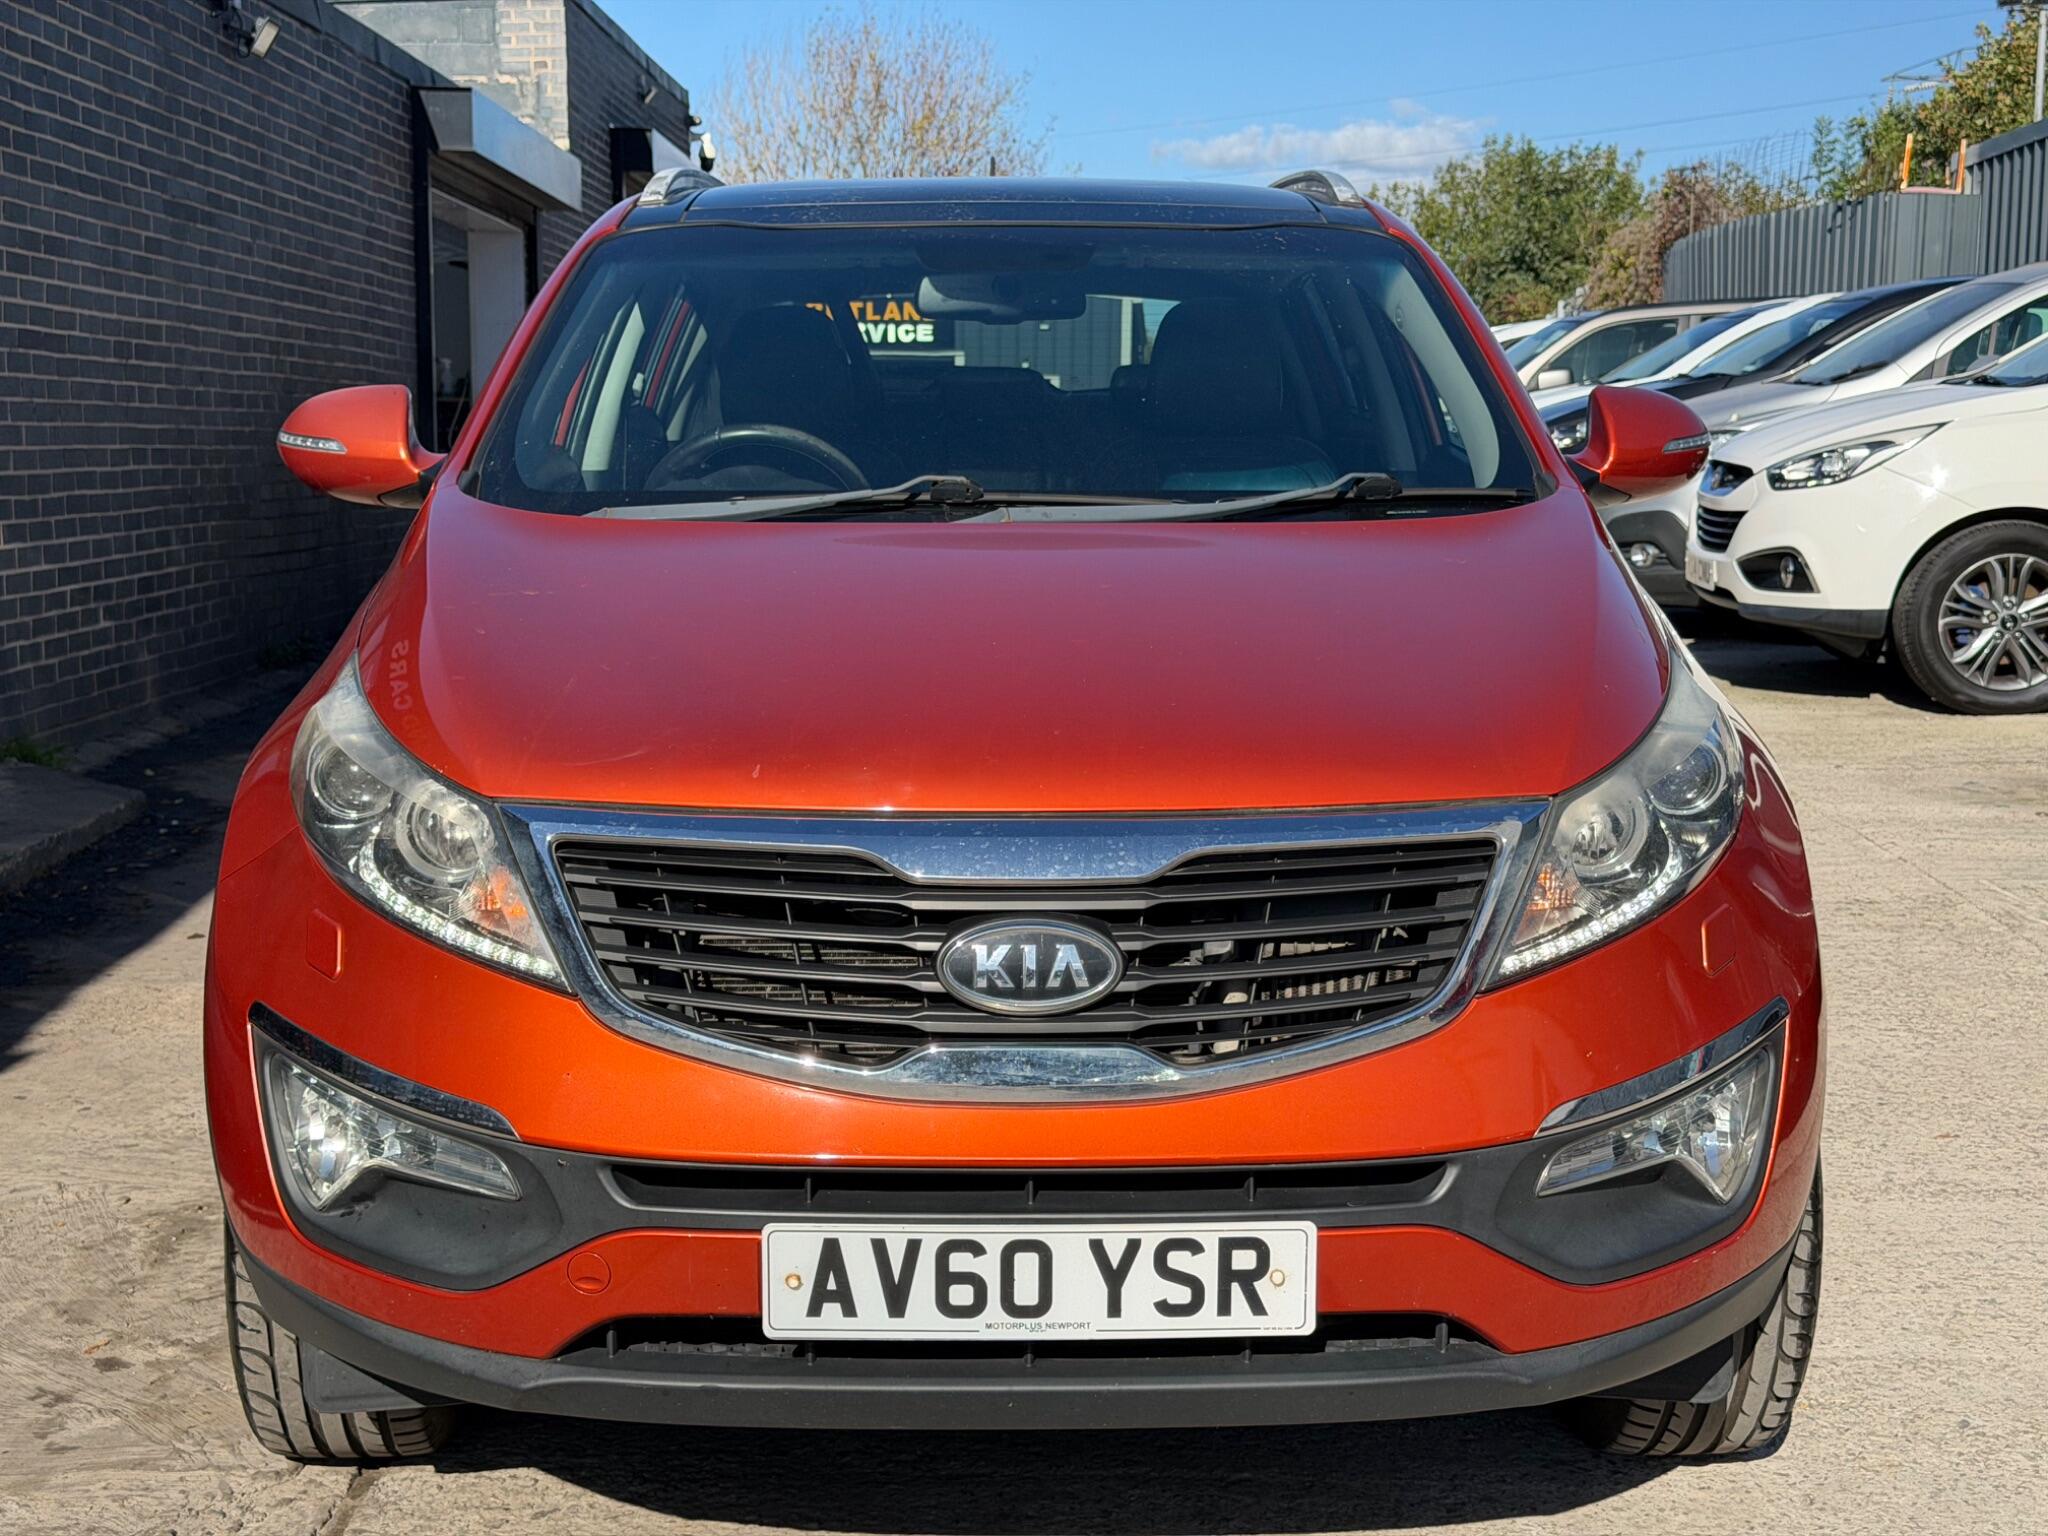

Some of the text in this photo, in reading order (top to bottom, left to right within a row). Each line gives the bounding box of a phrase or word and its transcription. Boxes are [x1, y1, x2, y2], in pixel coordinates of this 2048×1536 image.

[971, 944, 1090, 989] KIA
[806, 1236, 1271, 1319] AV60 YSR
[985, 1321, 1091, 1330] MOTORPLUS NEWPORT
